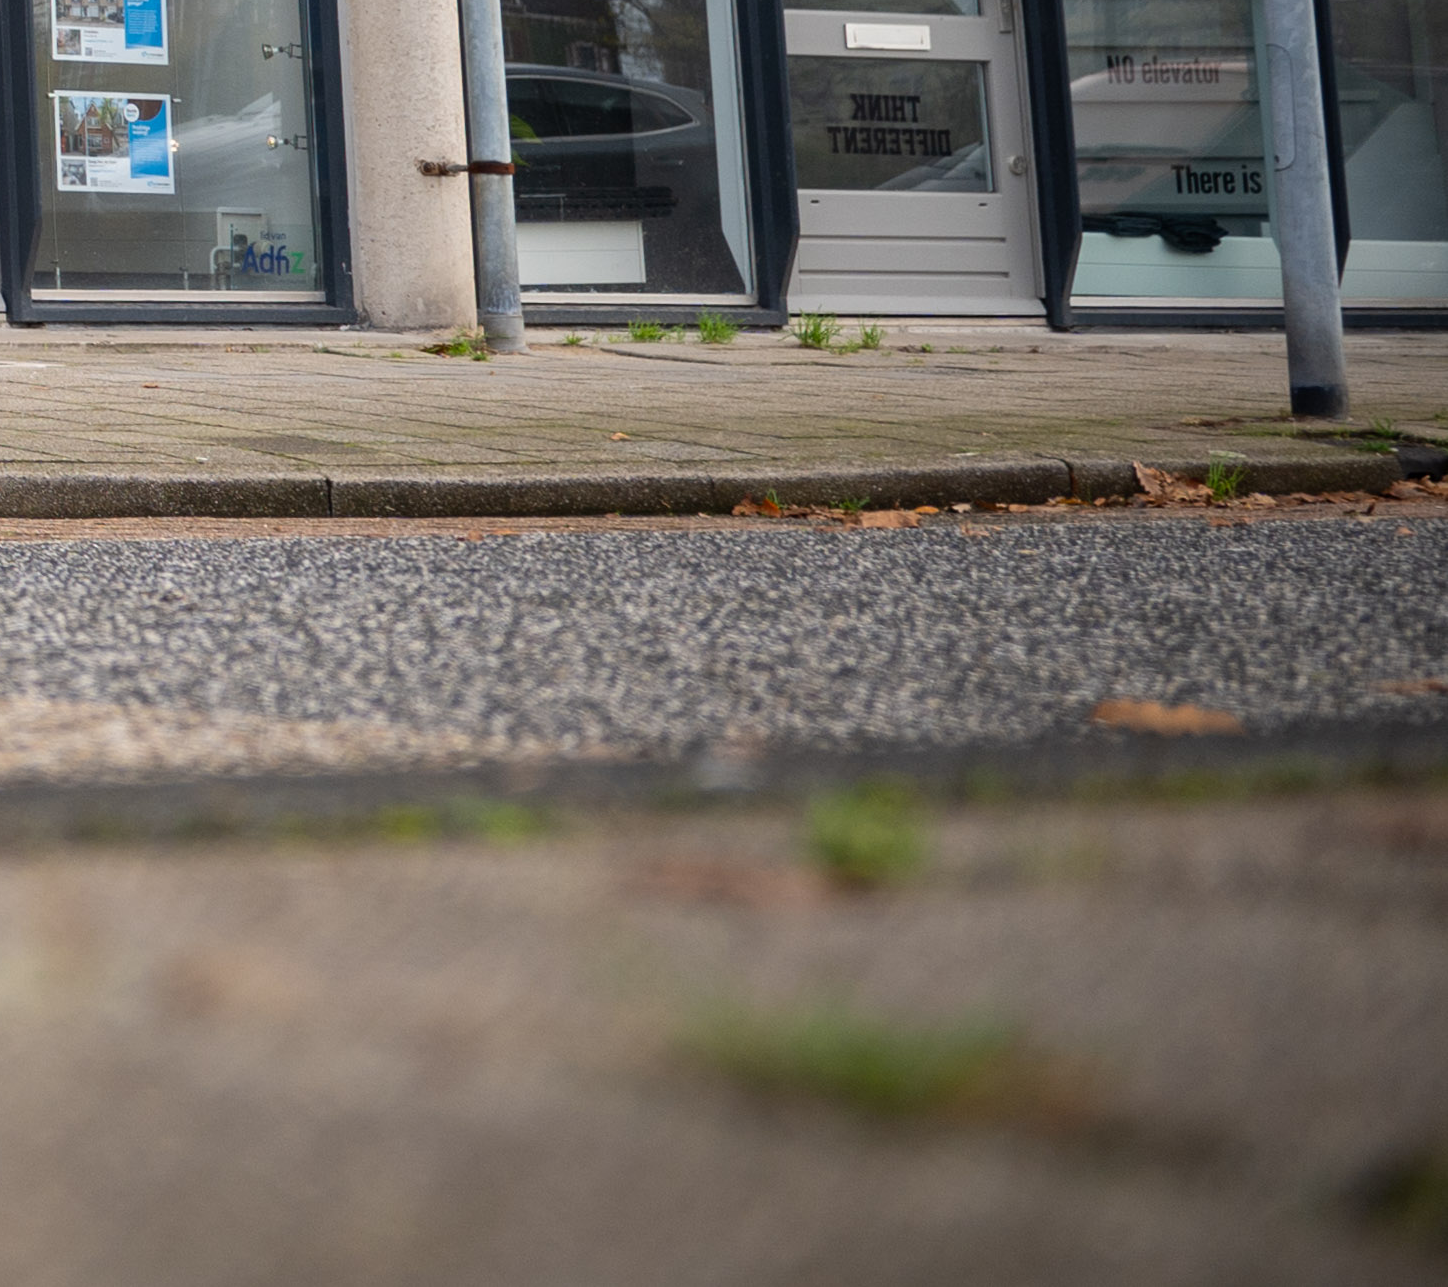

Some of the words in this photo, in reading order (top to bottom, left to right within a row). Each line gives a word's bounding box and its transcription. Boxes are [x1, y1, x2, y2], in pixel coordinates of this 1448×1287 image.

[1107, 55, 1134, 84] NO
[1142, 56, 1221, 84] elevator
[1171, 164, 1236, 194] There
[1241, 164, 1262, 194] is
